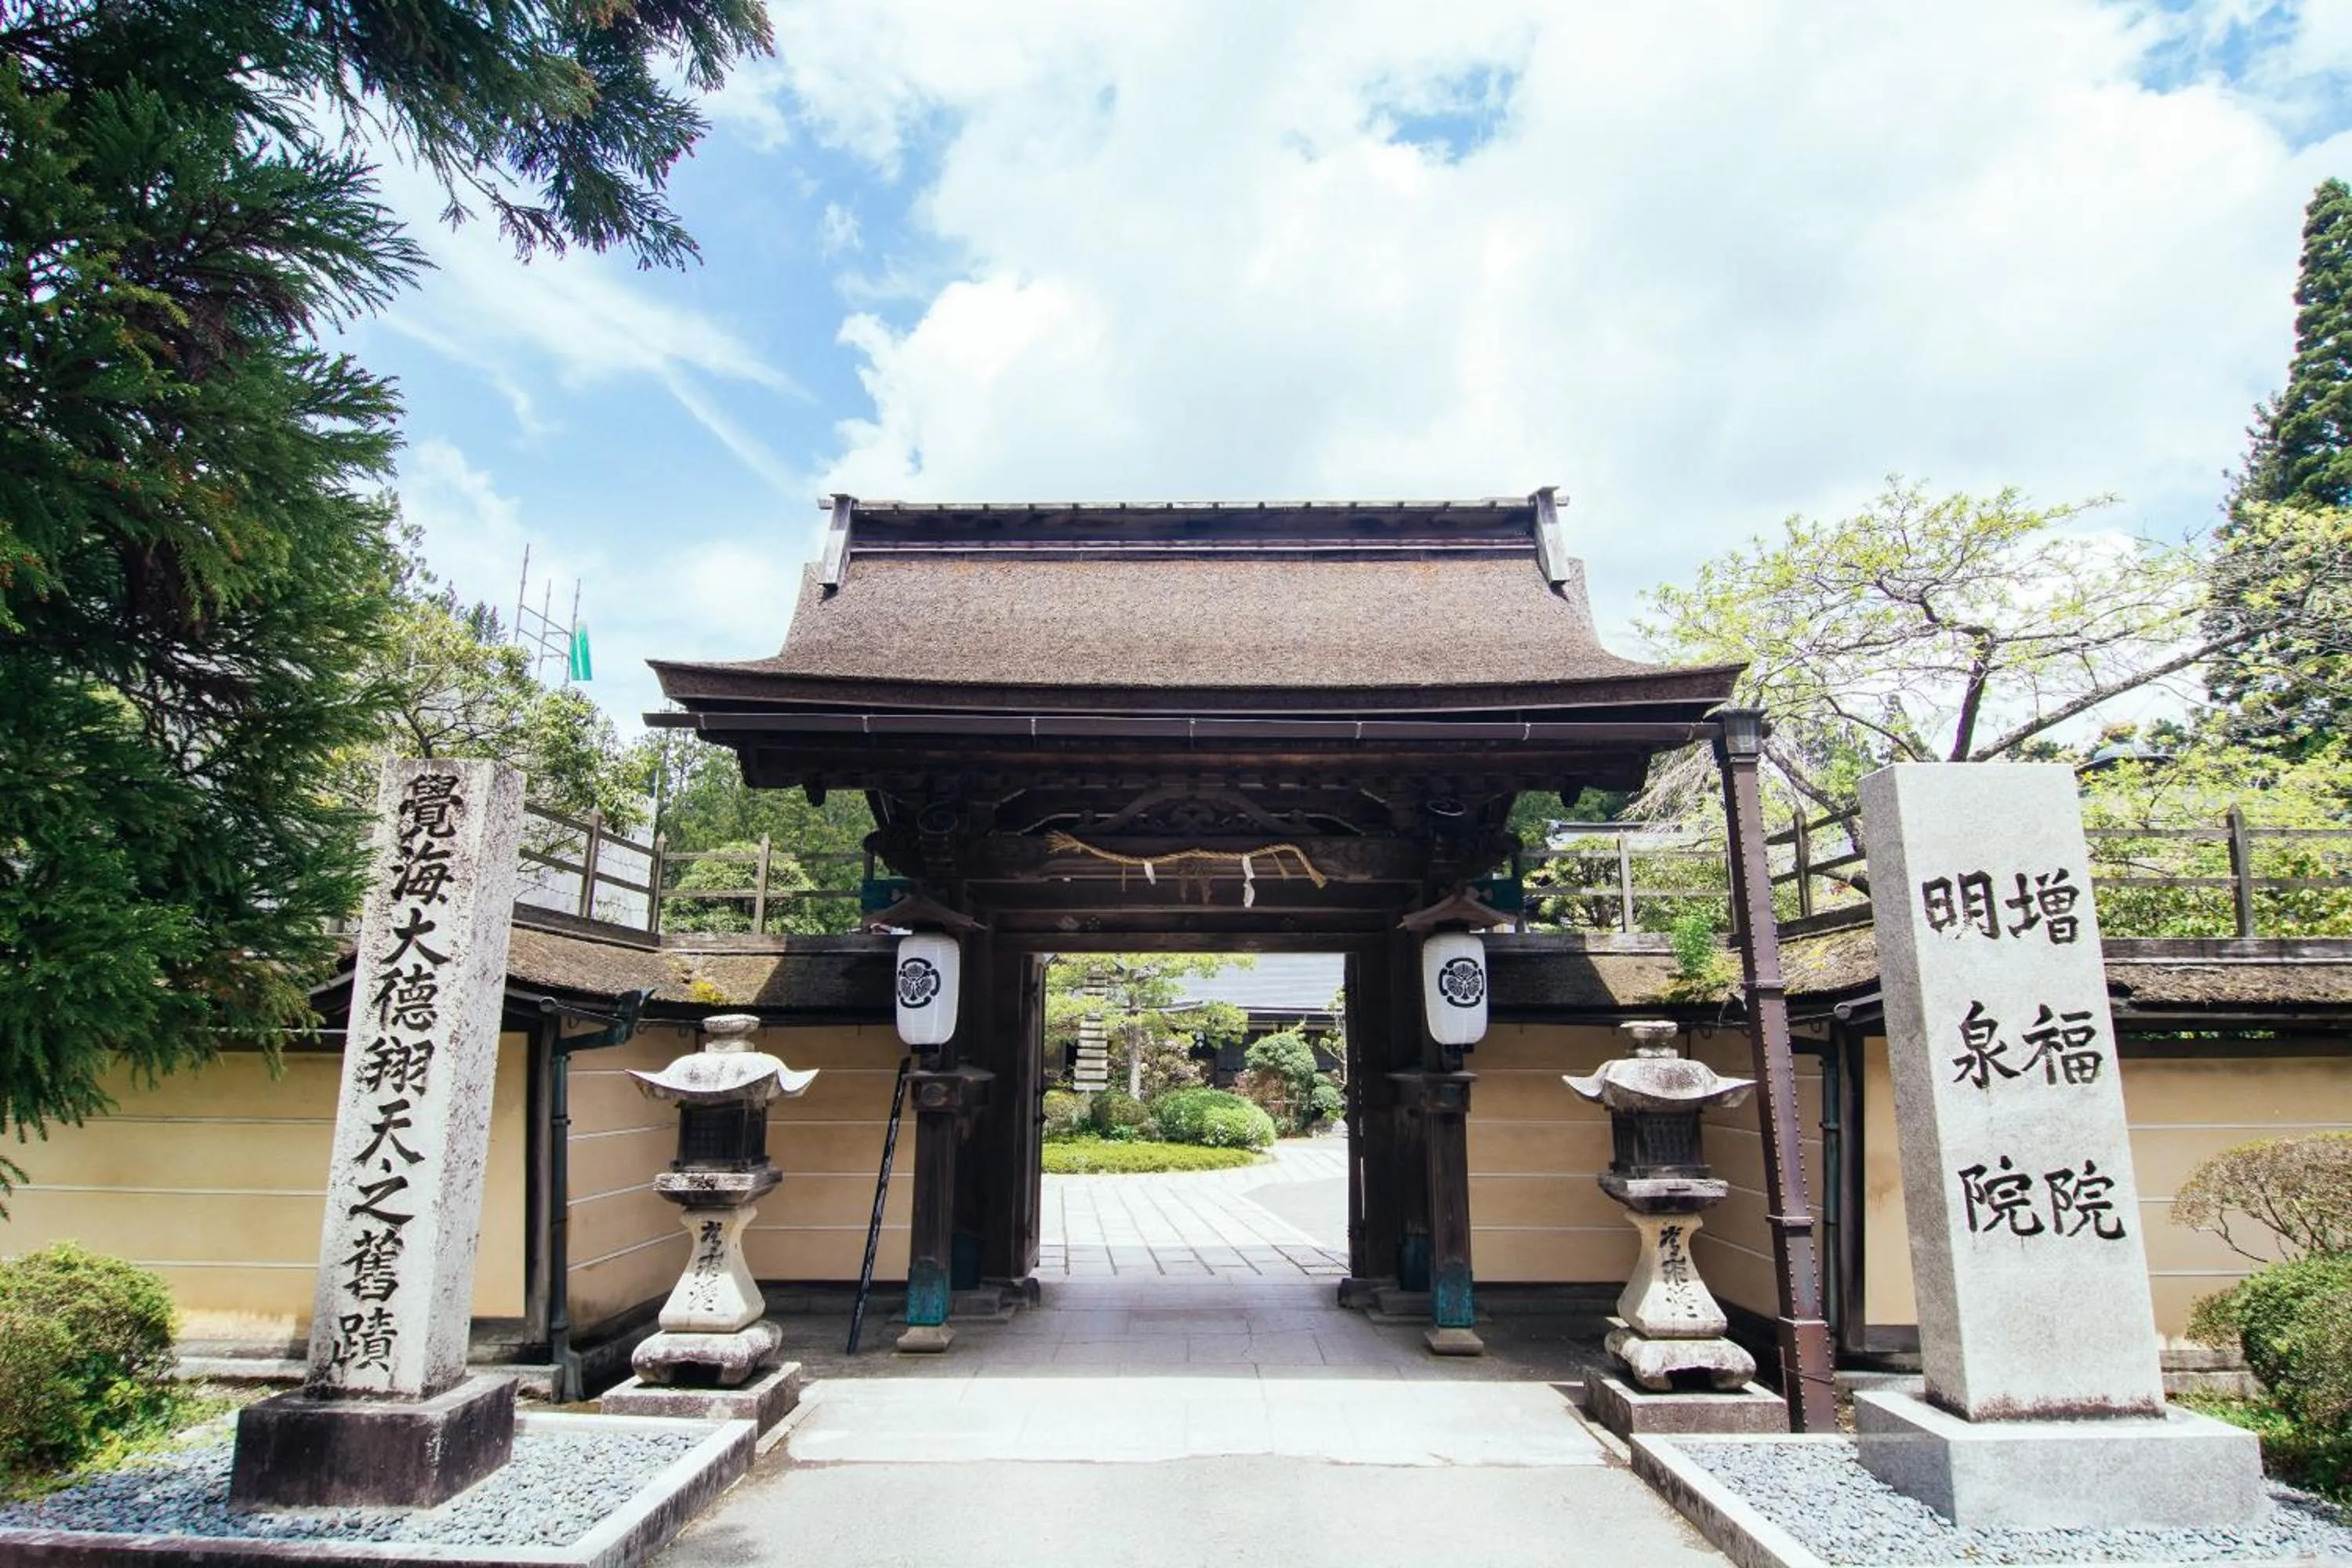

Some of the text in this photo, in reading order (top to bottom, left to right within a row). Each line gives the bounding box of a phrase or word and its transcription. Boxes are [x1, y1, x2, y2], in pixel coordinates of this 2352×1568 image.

[1922, 869, 2045, 1237] 明泉院
[2004, 868, 2127, 1240] 増福院
